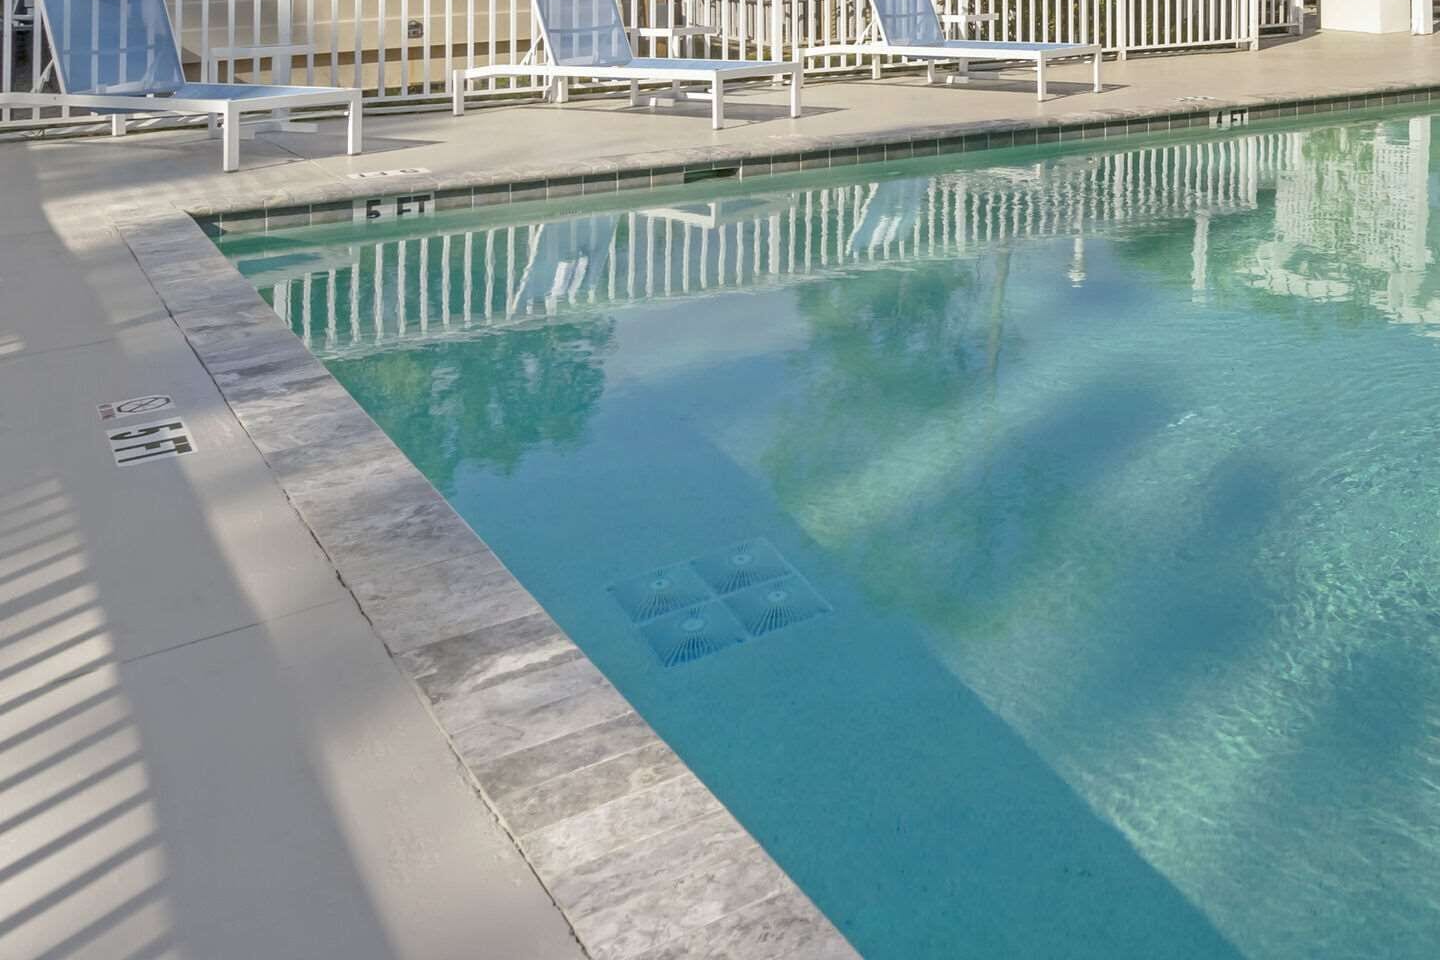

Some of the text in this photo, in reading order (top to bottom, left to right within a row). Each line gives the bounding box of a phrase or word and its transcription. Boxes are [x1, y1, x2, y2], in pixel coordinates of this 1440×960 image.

[1231, 109, 1248, 123] FT
[366, 194, 431, 219] 5 FT
[110, 422, 193, 463] 5 FT
